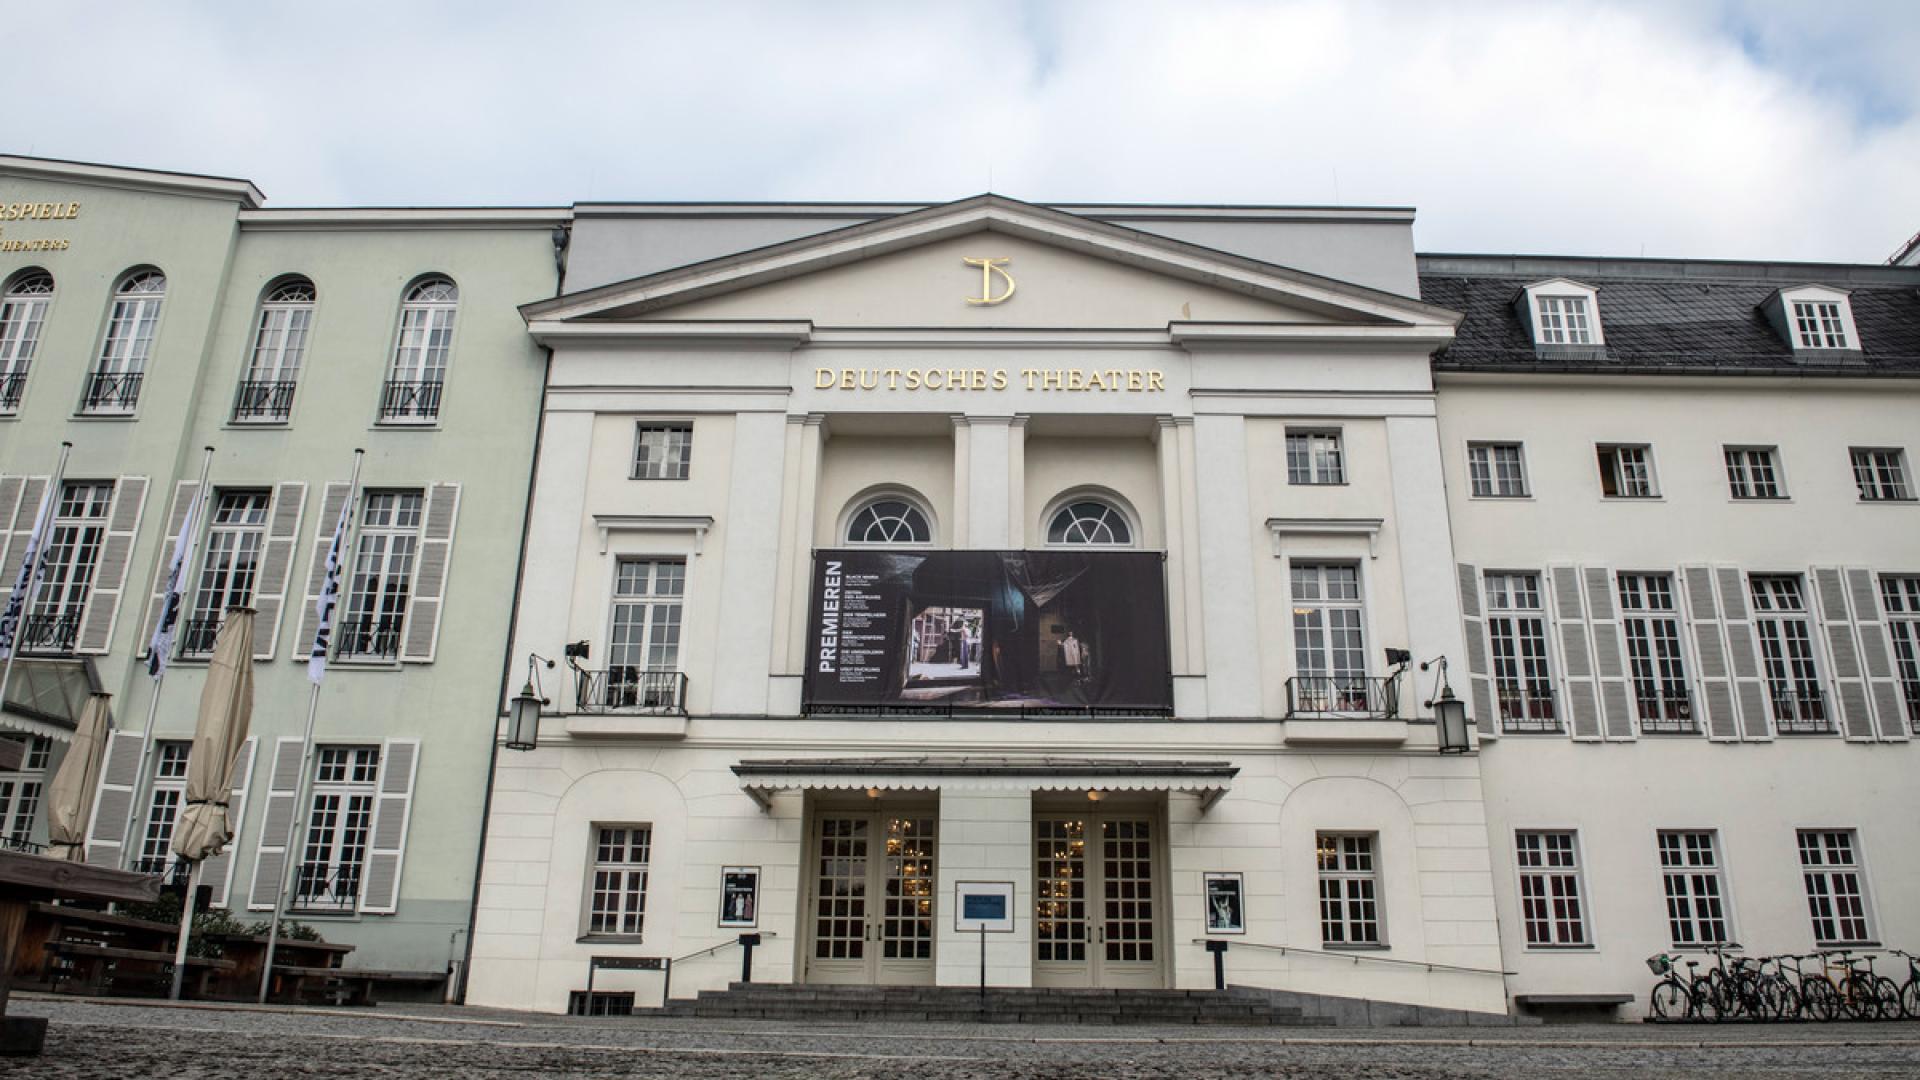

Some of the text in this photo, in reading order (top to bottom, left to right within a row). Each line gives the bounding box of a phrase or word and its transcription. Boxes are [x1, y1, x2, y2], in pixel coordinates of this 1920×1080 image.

[814, 367, 1165, 392] DEUTSCHES THEATER
[818, 560, 843, 673] PREMIEREN
